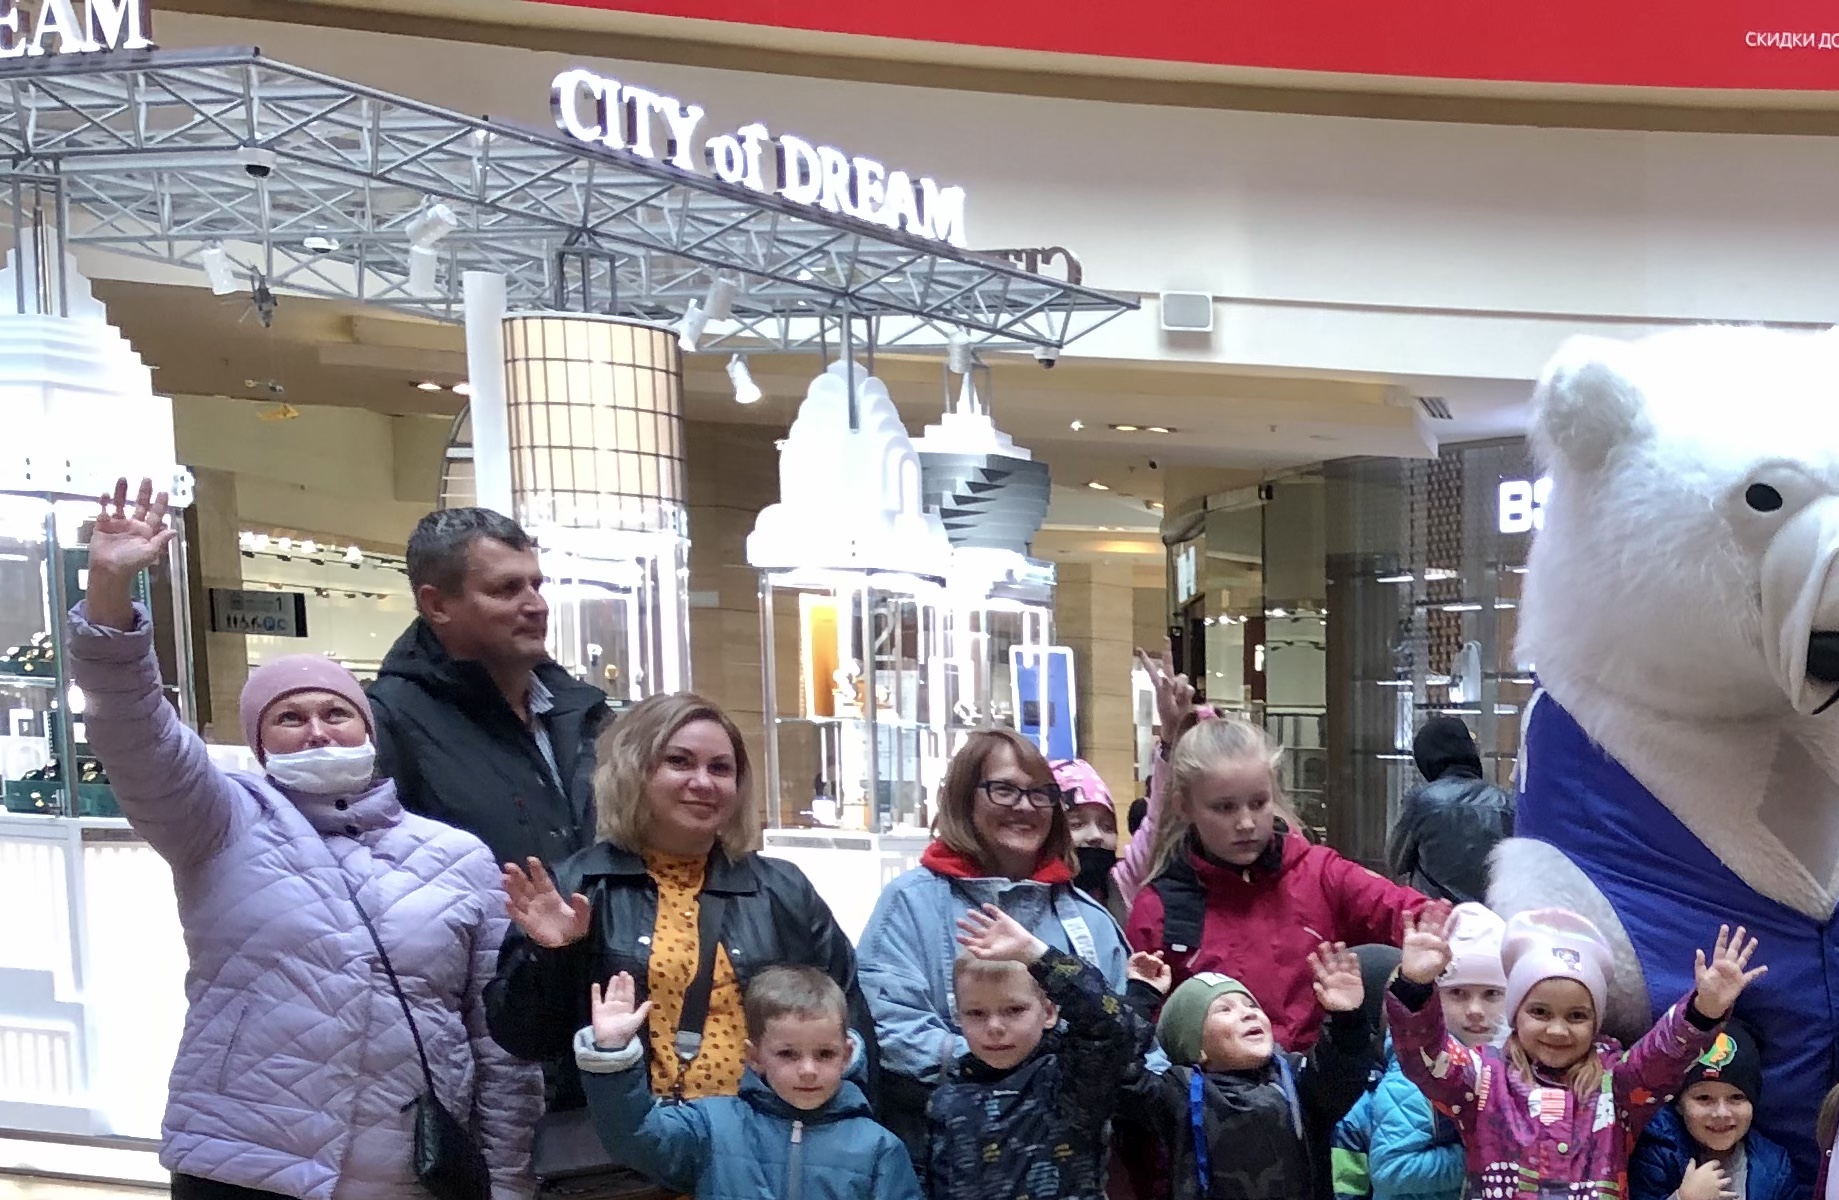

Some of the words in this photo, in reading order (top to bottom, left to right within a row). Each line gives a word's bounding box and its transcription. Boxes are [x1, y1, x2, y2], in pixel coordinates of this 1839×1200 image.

[1745, 31, 1816, 49] СКИДКИ
[551, 69, 704, 171] CITY
[705, 122, 770, 194] of
[774, 134, 967, 250] DREAM
